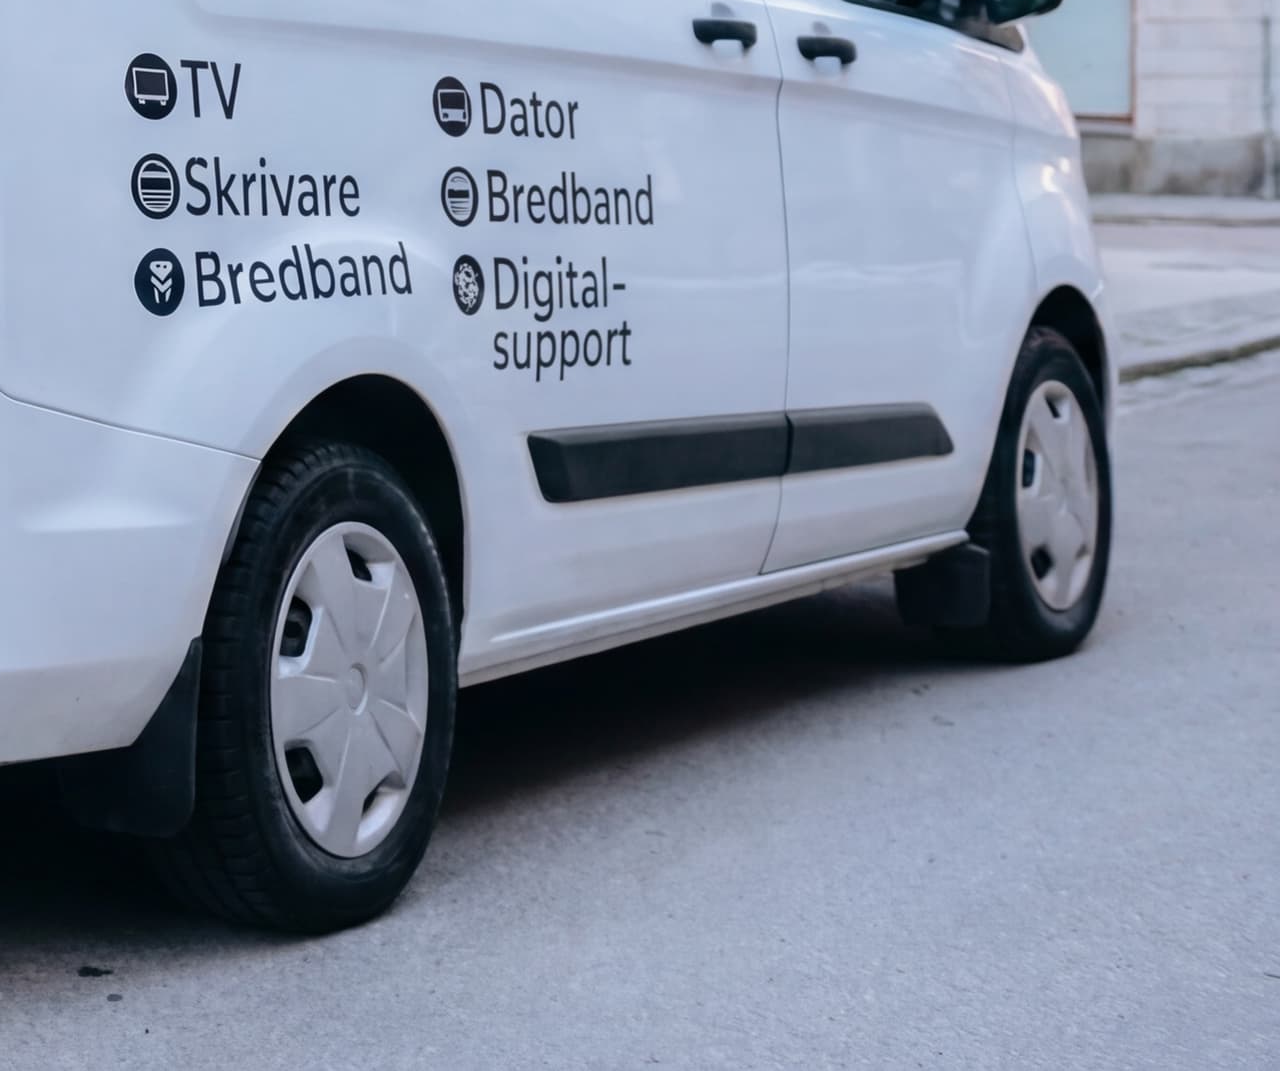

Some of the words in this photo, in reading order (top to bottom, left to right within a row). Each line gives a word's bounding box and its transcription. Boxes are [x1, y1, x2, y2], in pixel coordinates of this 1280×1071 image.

[180, 60, 241, 120] TV
[480, 81, 578, 140] Dator
[185, 156, 361, 217] Skrivare
[486, 169, 654, 226] Bredband
[194, 241, 413, 308] Bredband
[493, 256, 626, 323] Digital-
[493, 321, 632, 382] support
